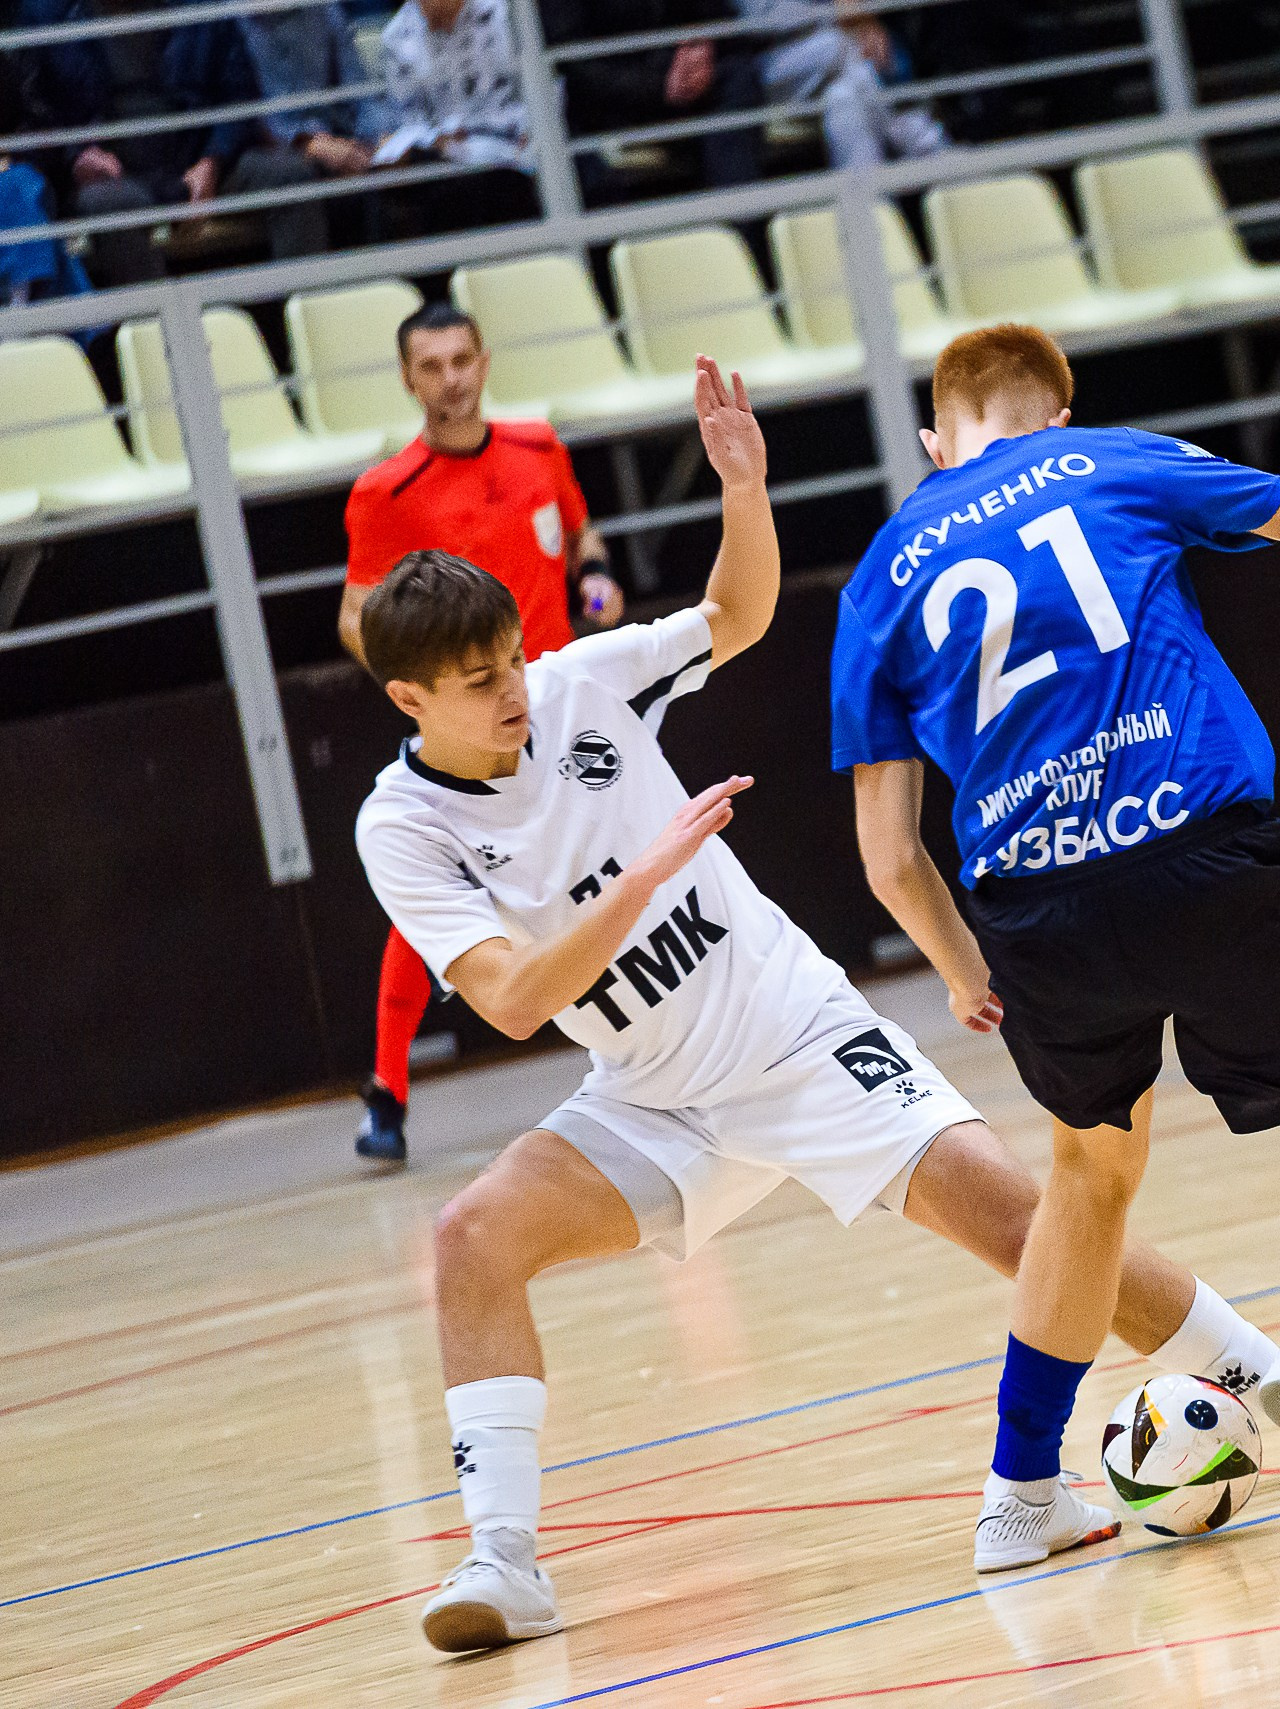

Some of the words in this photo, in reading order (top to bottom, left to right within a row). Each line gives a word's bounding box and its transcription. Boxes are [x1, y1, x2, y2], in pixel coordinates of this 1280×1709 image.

[890, 452, 1096, 588] СКУЧЕНКО
[921, 504, 1131, 735] 21
[901, 1089, 933, 1109] KELME
